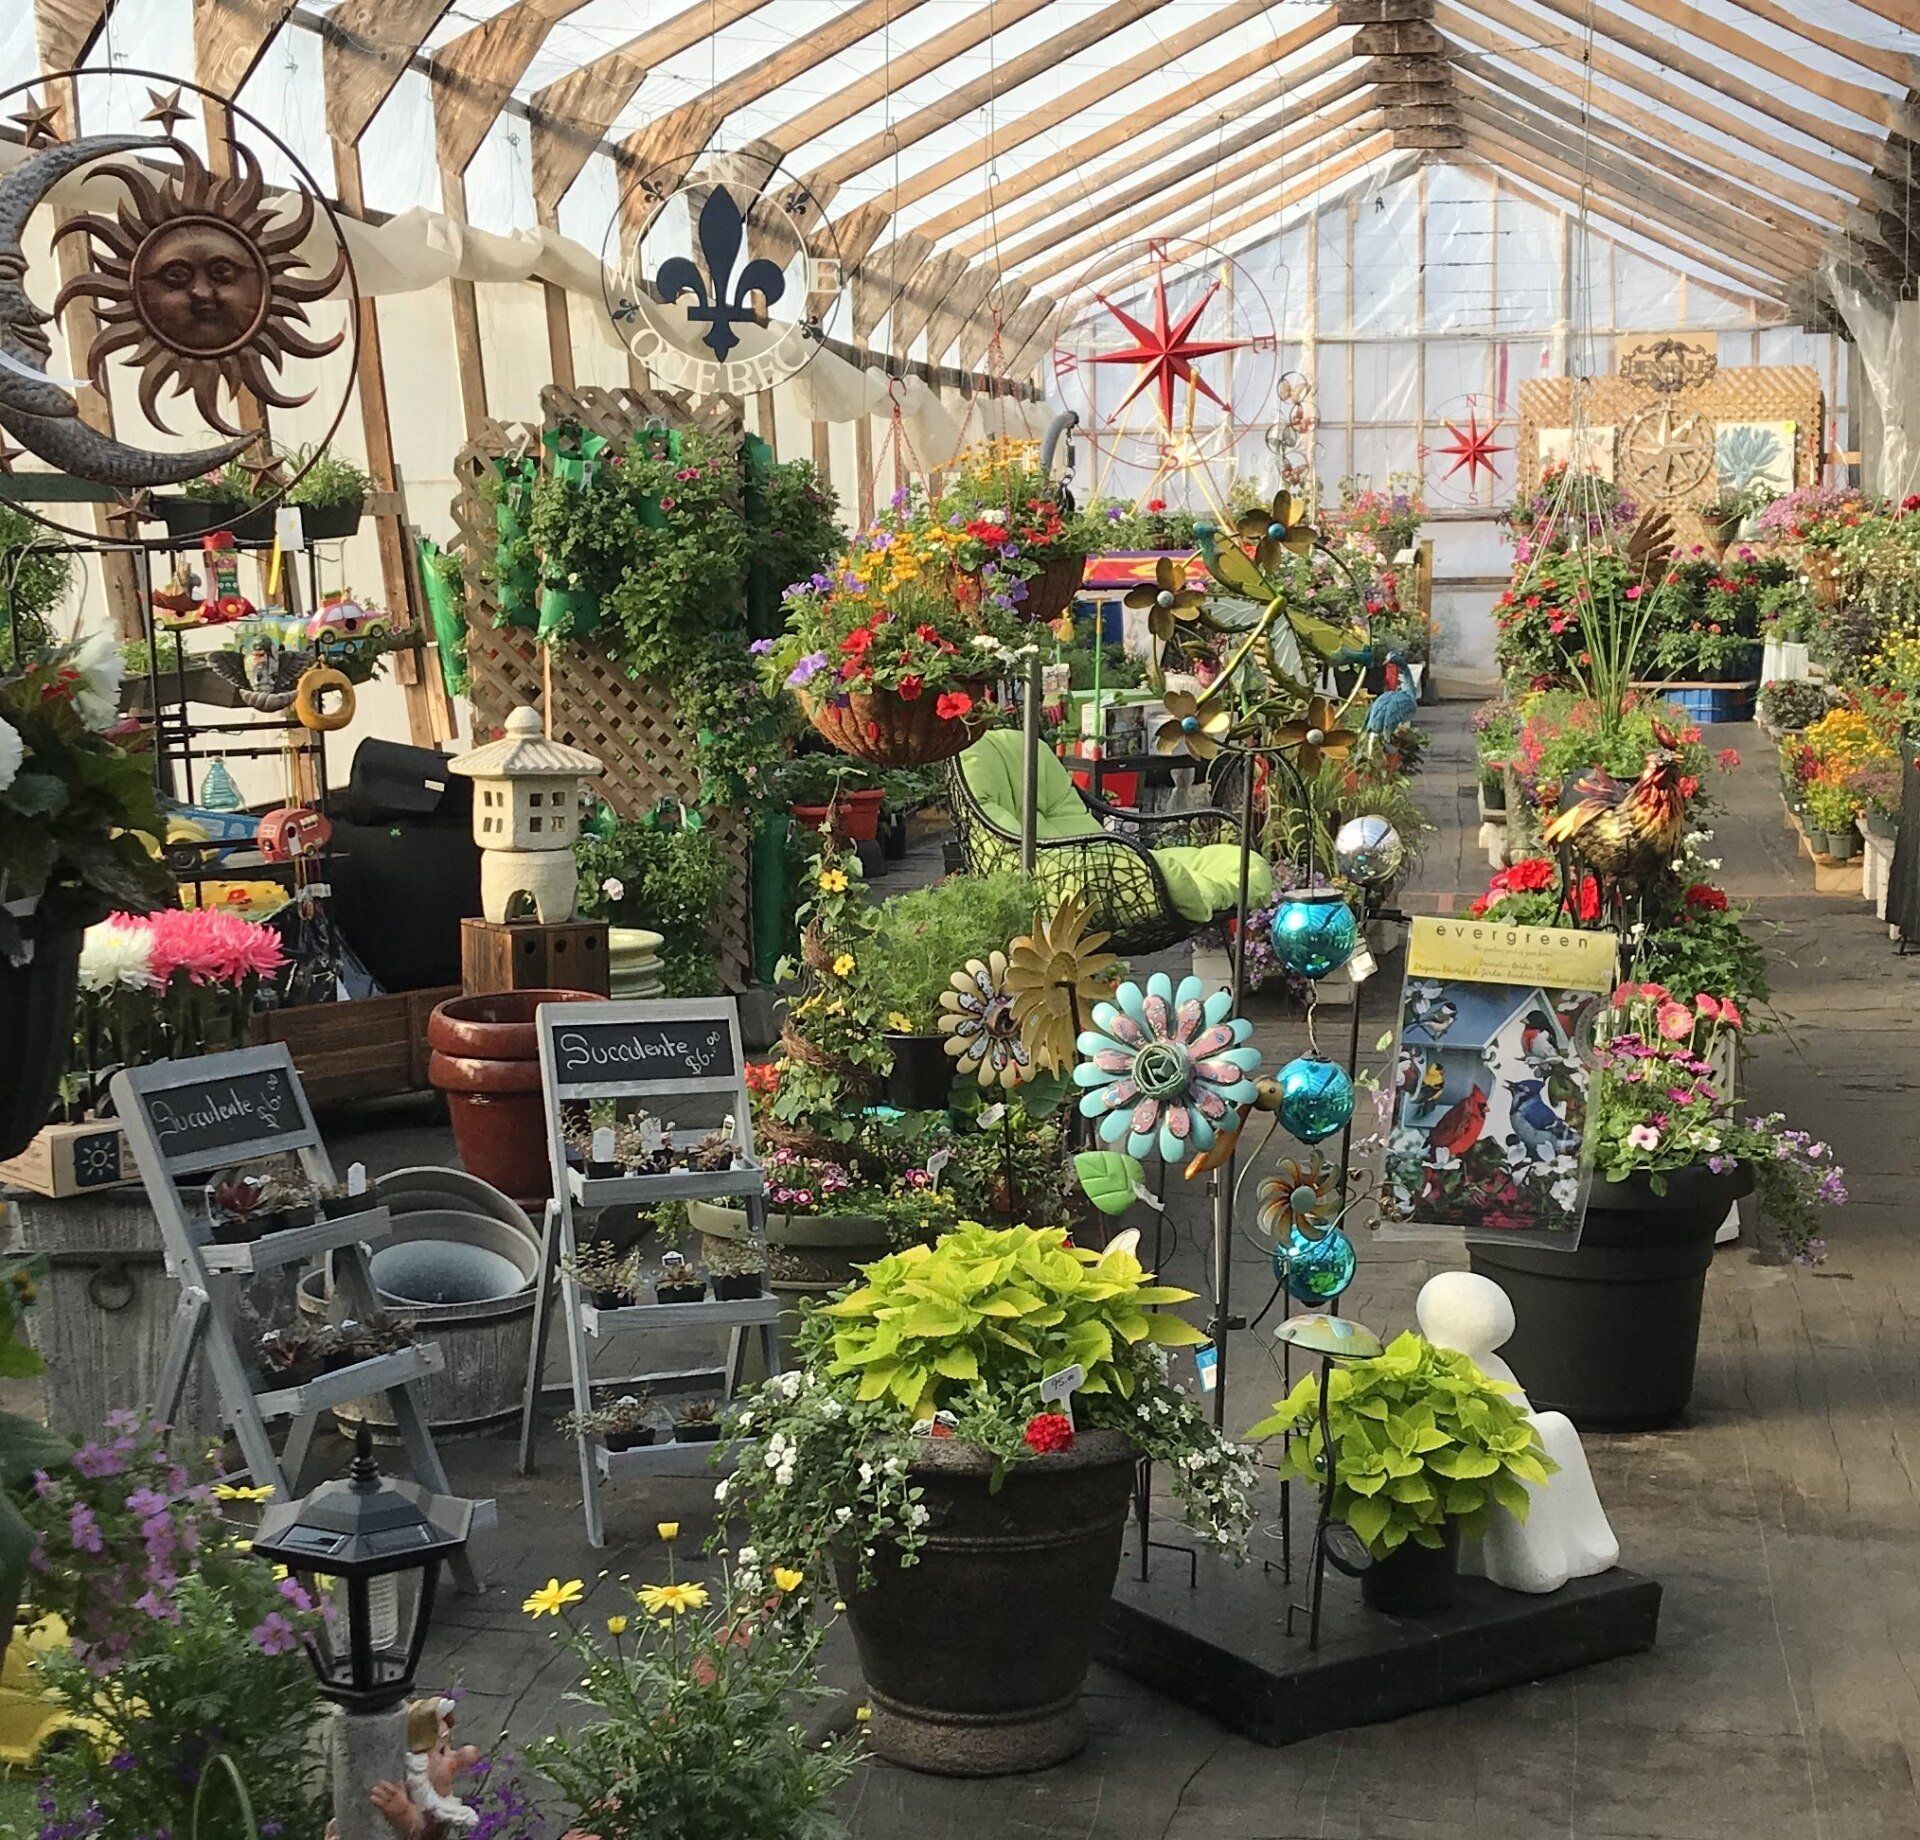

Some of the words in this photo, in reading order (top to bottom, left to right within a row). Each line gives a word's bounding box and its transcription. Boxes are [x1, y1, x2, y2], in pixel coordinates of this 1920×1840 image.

[1149, 237, 1169, 263] N
[807, 257, 842, 293] E
[1465, 394, 1477, 408] N
[1436, 924, 1589, 948] evergreen
[560, 1032, 688, 1071] Succulente
[151, 1087, 254, 1143] Succulente
